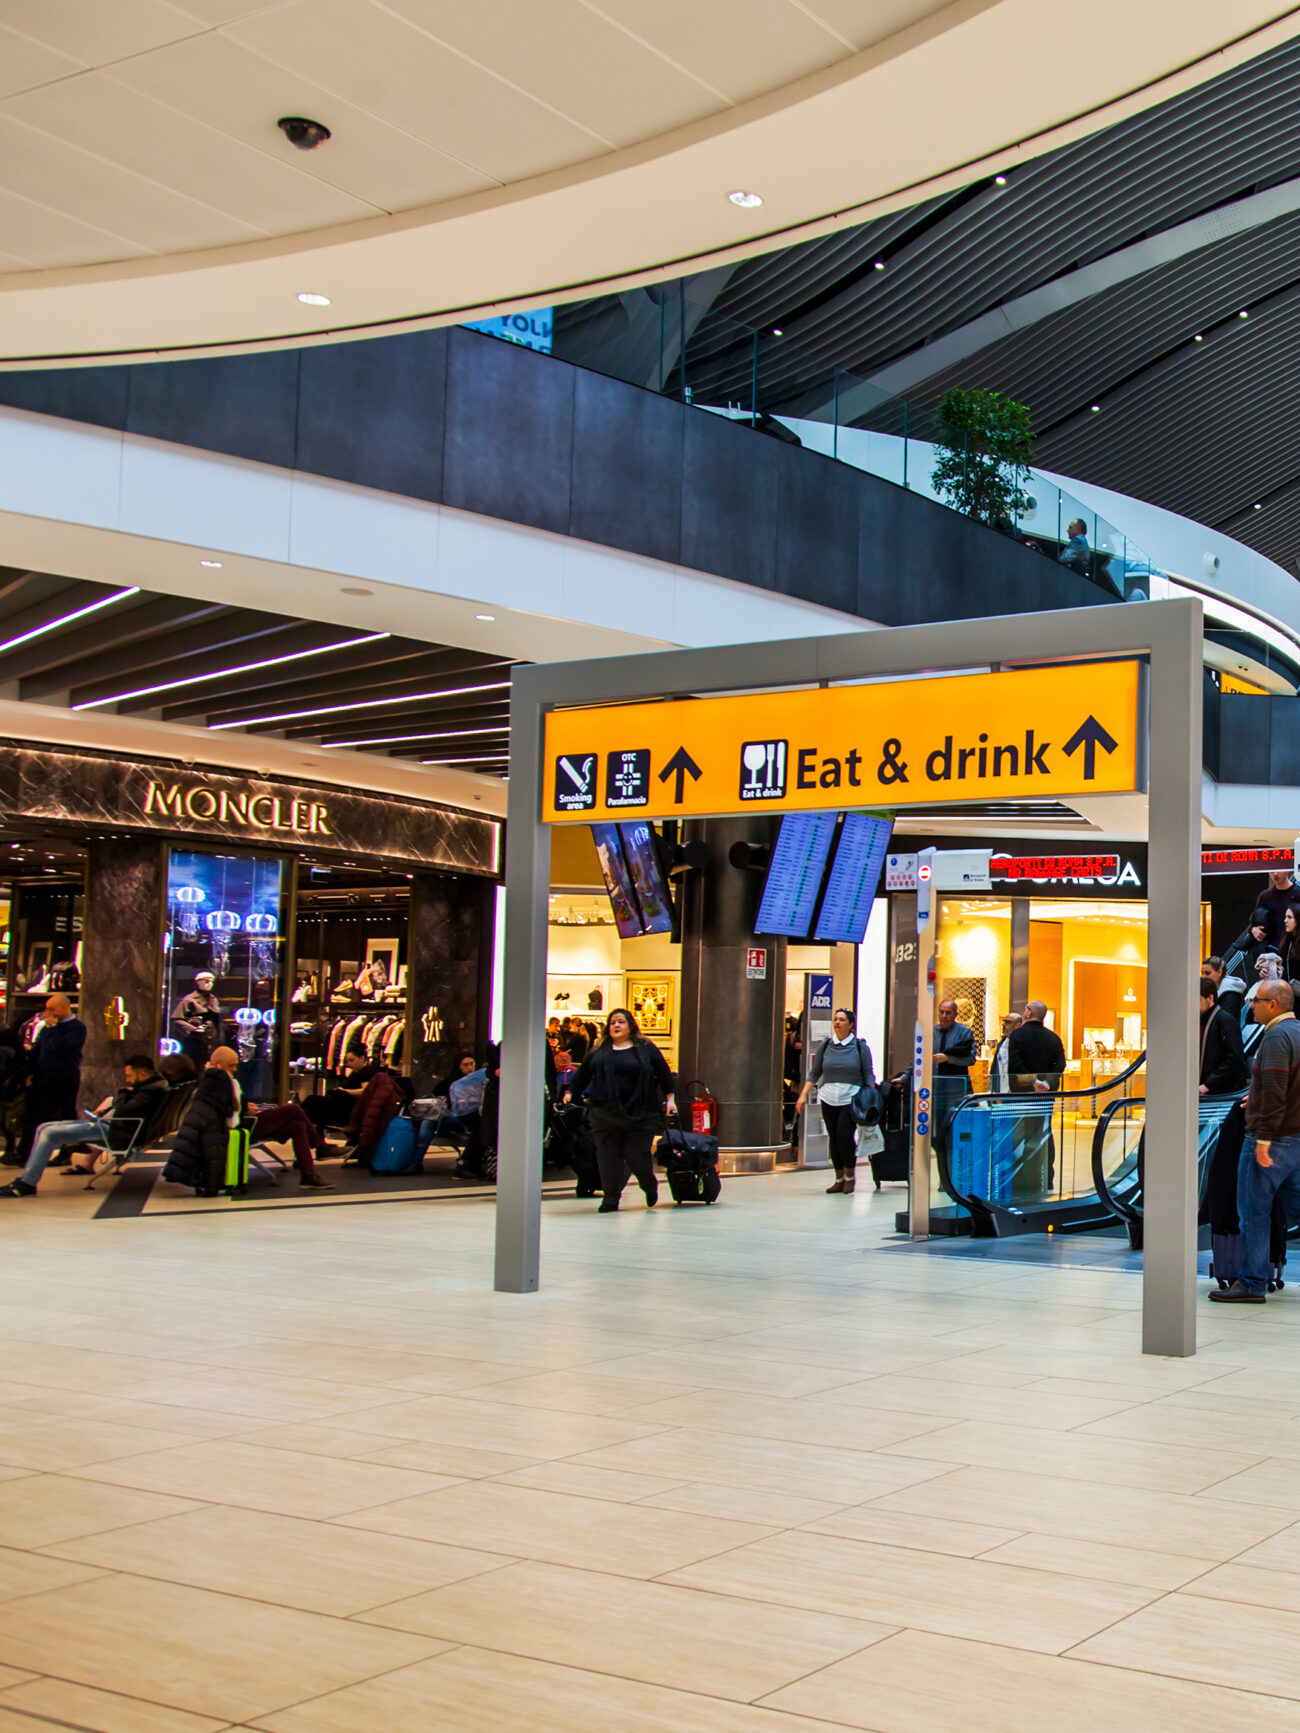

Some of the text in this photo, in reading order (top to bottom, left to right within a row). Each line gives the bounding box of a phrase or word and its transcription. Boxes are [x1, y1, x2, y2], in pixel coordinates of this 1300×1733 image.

[621, 752, 637, 761] OTC
[796, 729, 1052, 790] Eat & drink
[742, 789, 755, 798] Eat
[762, 787, 783, 797] drink
[559, 793, 593, 804] Smoking
[607, 795, 647, 806] Parafarmacia
[144, 780, 334, 835] MONCLER
[566, 802, 584, 810] area
[1215, 851, 1229, 862] DI
[1230, 849, 1259, 861] ROMA
[1261, 848, 1295, 860] S.P.A.
[811, 996, 831, 1008] ADR
